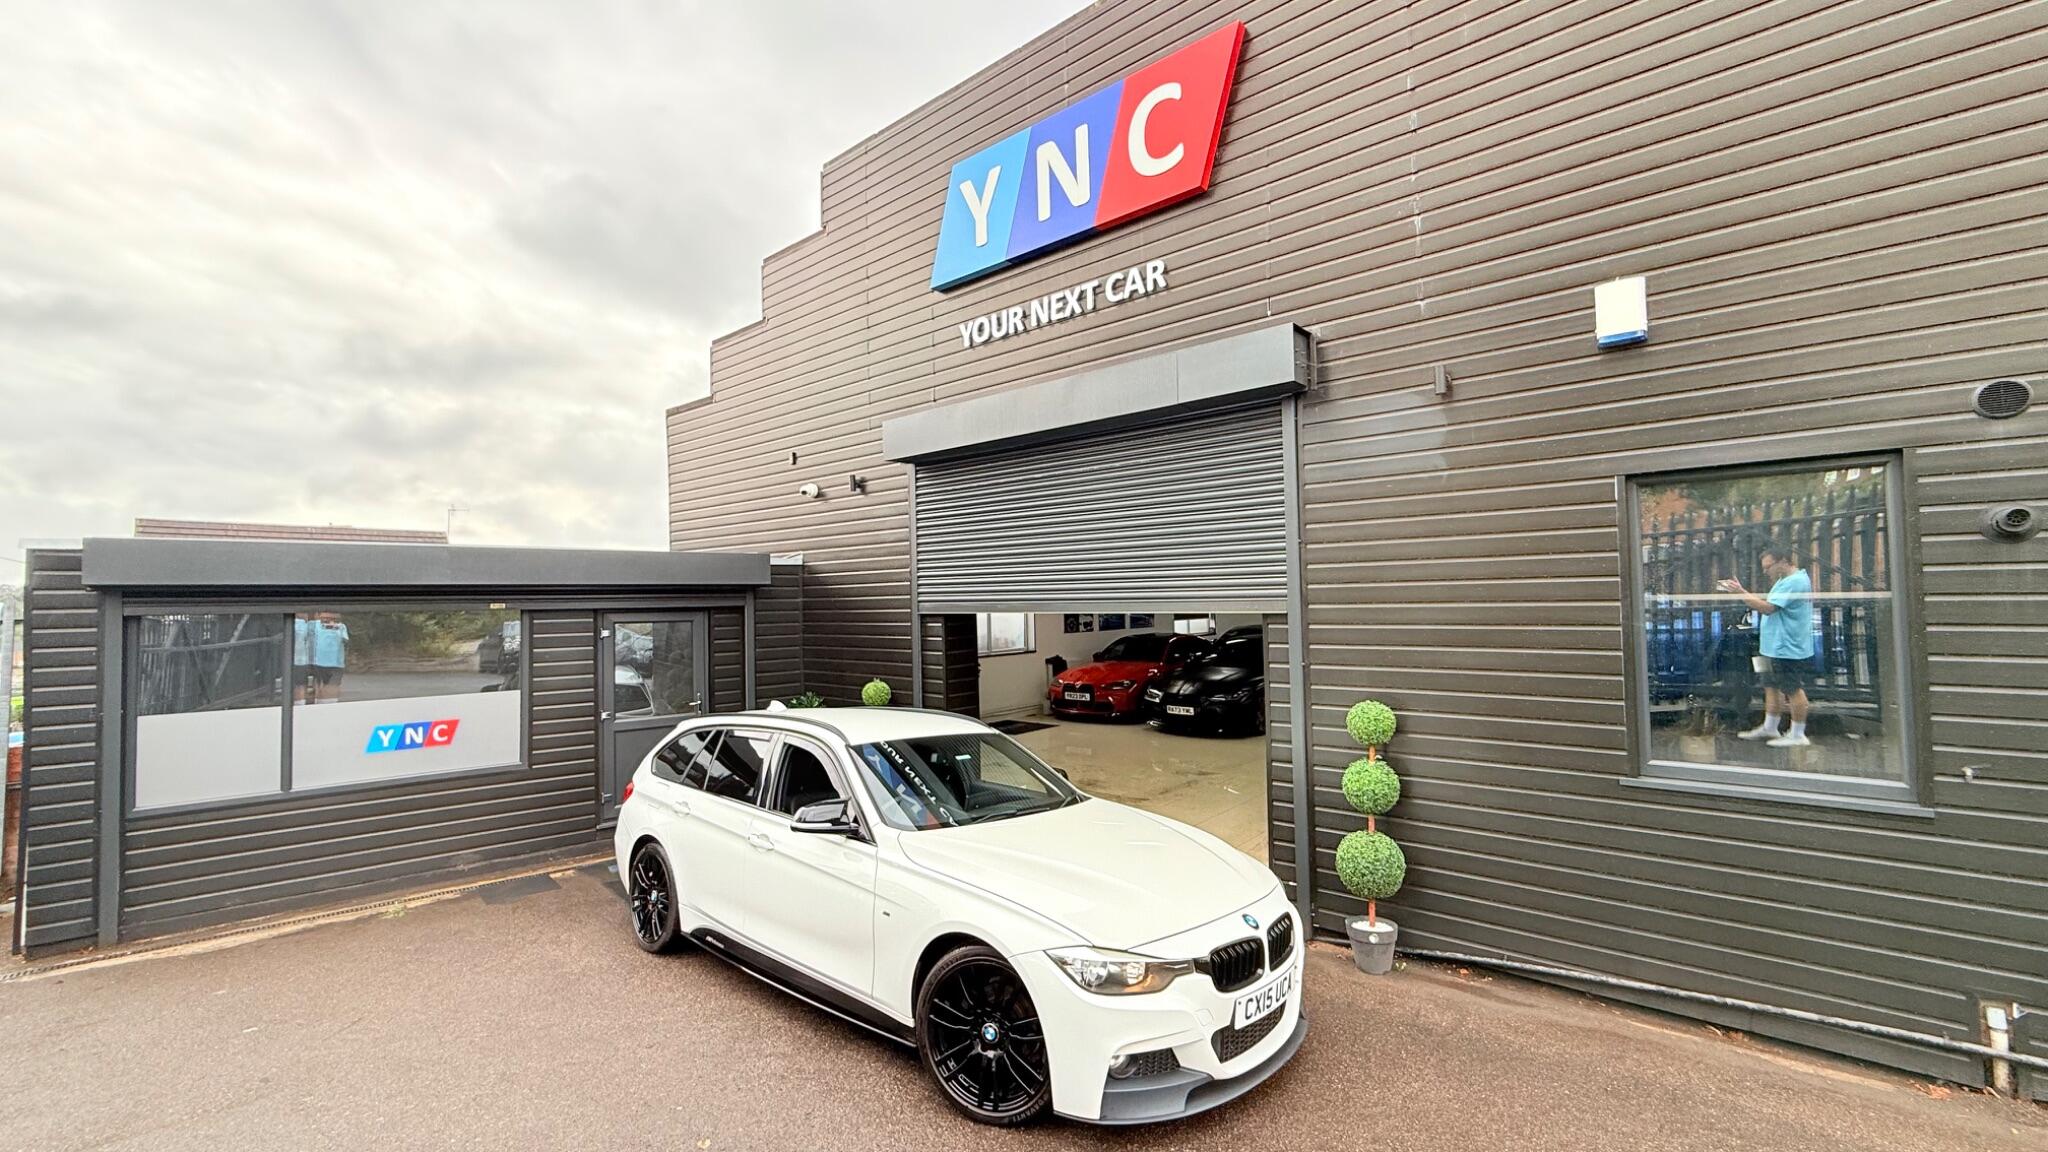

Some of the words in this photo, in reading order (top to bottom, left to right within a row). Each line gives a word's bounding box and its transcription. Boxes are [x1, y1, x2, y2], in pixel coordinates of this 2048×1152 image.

[960, 82, 1185, 247] YNC
[959, 305, 1026, 348] YOUR
[1030, 280, 1099, 327] NEXT
[1105, 259, 1168, 303] CAR
[377, 724, 448, 747] YNC
[1245, 986, 1273, 1020] CX15
[1275, 972, 1292, 1001] UCA
